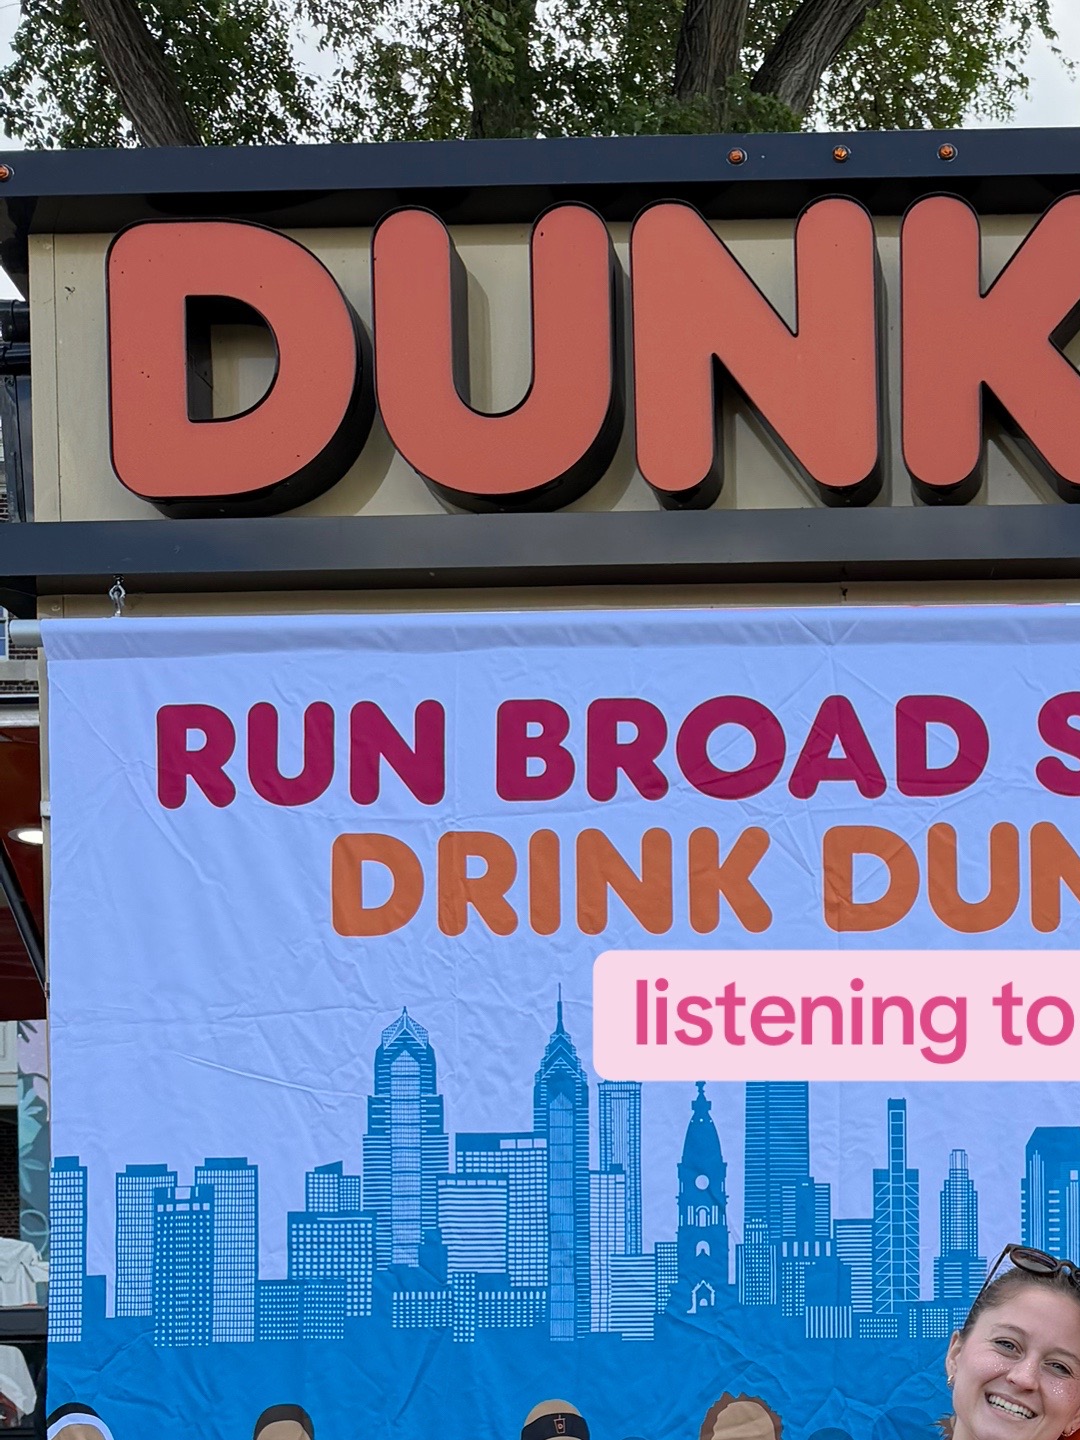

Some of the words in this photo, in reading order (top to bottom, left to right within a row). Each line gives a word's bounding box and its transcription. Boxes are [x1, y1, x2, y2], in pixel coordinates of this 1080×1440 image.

[156, 699, 446, 809] RUN
[495, 695, 990, 803] BROAD
[331, 826, 773, 938] DRINK
